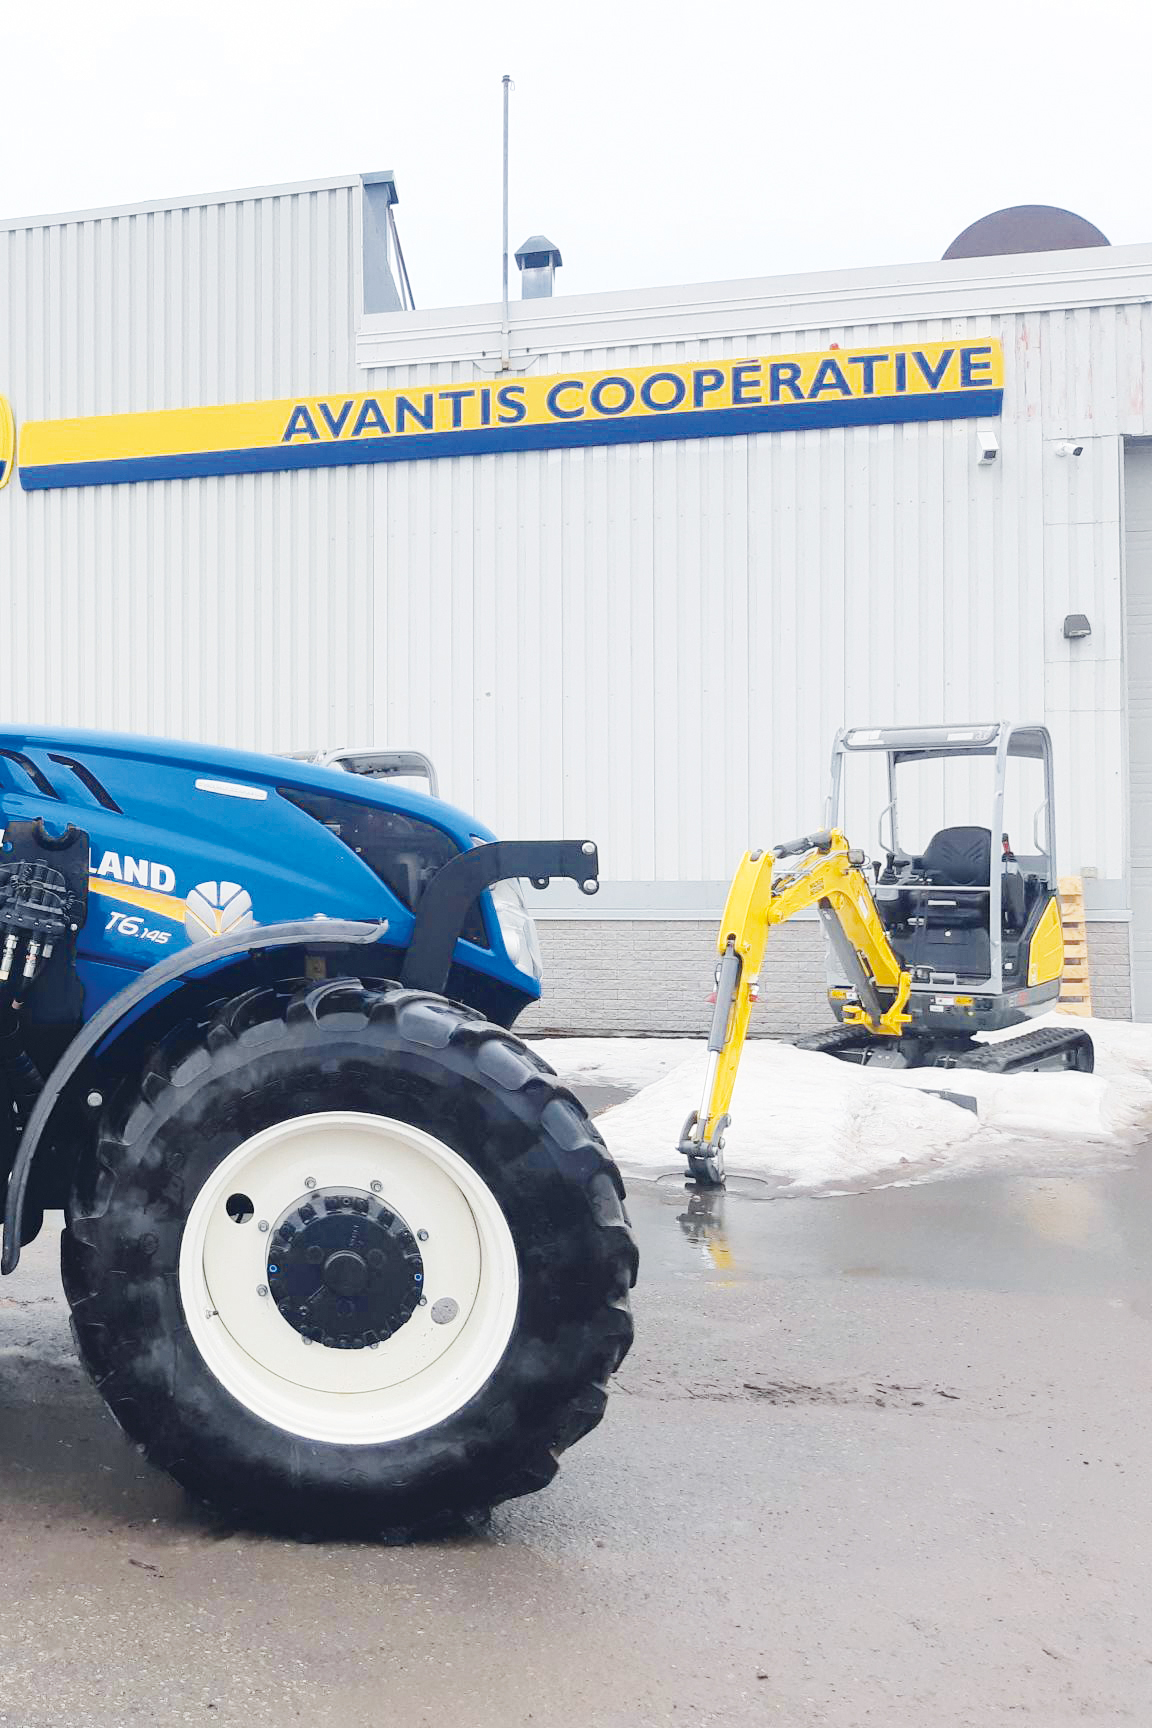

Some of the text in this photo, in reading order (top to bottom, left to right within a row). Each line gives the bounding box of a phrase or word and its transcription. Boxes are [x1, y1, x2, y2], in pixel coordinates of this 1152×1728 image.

[281, 345, 994, 443] AVANTIS COOPÉRATIVE
[88, 847, 176, 892] LAND
